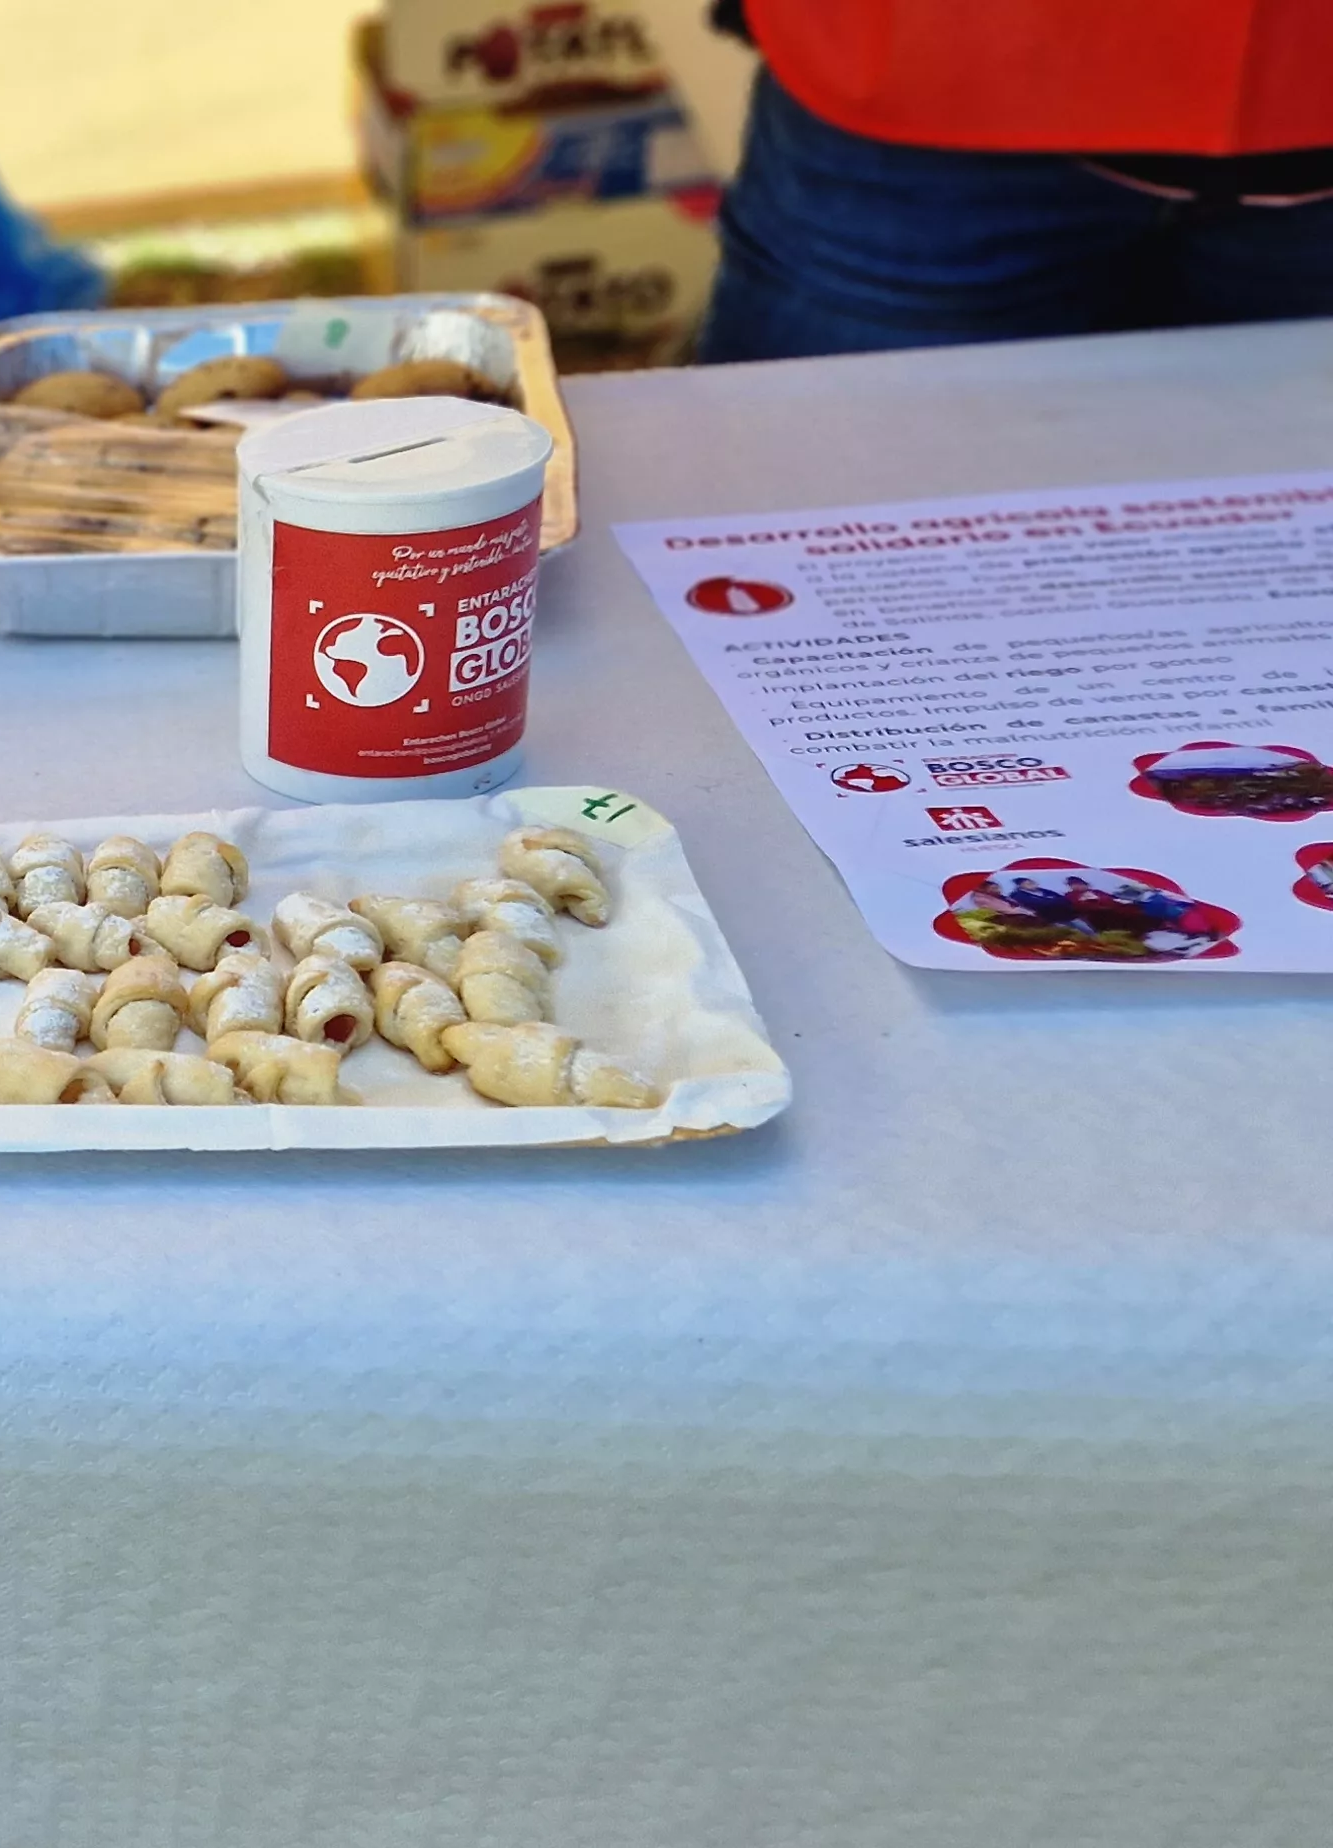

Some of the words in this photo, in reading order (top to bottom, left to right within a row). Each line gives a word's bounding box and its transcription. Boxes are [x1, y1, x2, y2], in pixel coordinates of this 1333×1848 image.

[391, 545, 425, 562] Por
[428, 549, 446, 559] un
[445, 532, 488, 556] mundo
[665, 522, 899, 551] Desarrollo
[910, 506, 1109, 531] agrícola
[804, 530, 1010, 556] solidario
[1023, 525, 1082, 538] en
[1092, 509, 1294, 533] Ecuador
[371, 562, 439, 588] equitativo
[437, 566, 451, 584] y
[455, 585, 536, 649] BOSC
[724, 632, 910, 653] ACTIVIDADES
[737, 661, 869, 680] orgánicos
[875, 662, 892, 672] y
[900, 654, 1000, 669] crianza
[1009, 651, 1044, 661] de
[1052, 641, 1194, 659] pequeños
[753, 645, 933, 666] Capacitación
[953, 641, 988, 651] de
[1006, 628, 1187, 649] pequeños/as
[761, 673, 944, 695] Implantación
[954, 670, 999, 682] del
[1005, 665, 1082, 680] riego
[1092, 661, 1137, 673] por
[1147, 654, 1233, 669] goteo
[791, 689, 988, 711] Equipamiento
[1014, 684, 1051, 696] de
[1077, 681, 1115, 691] un
[1141, 673, 1236, 687] centro
[1262, 669, 1299, 681] de
[451, 688, 493, 707] ONGD
[769, 707, 917, 728] productos.
[924, 699, 1039, 716] Impulso
[1048, 696, 1083, 706] de
[1090, 689, 1174, 704] venta
[1181, 686, 1230, 700] por
[789, 738, 919, 755] combatir
[929, 736, 955, 747] la
[963, 724, 1158, 747] malnutrición
[1164, 717, 1274, 734] infantil
[804, 721, 988, 742] Distribución
[1006, 718, 1044, 729] de
[1063, 709, 1201, 726] canastas
[1220, 707, 1238, 717] a
[925, 757, 1044, 774] BOSCO
[935, 767, 1065, 786] GLOBAL
[902, 828, 1067, 848] salesianos
